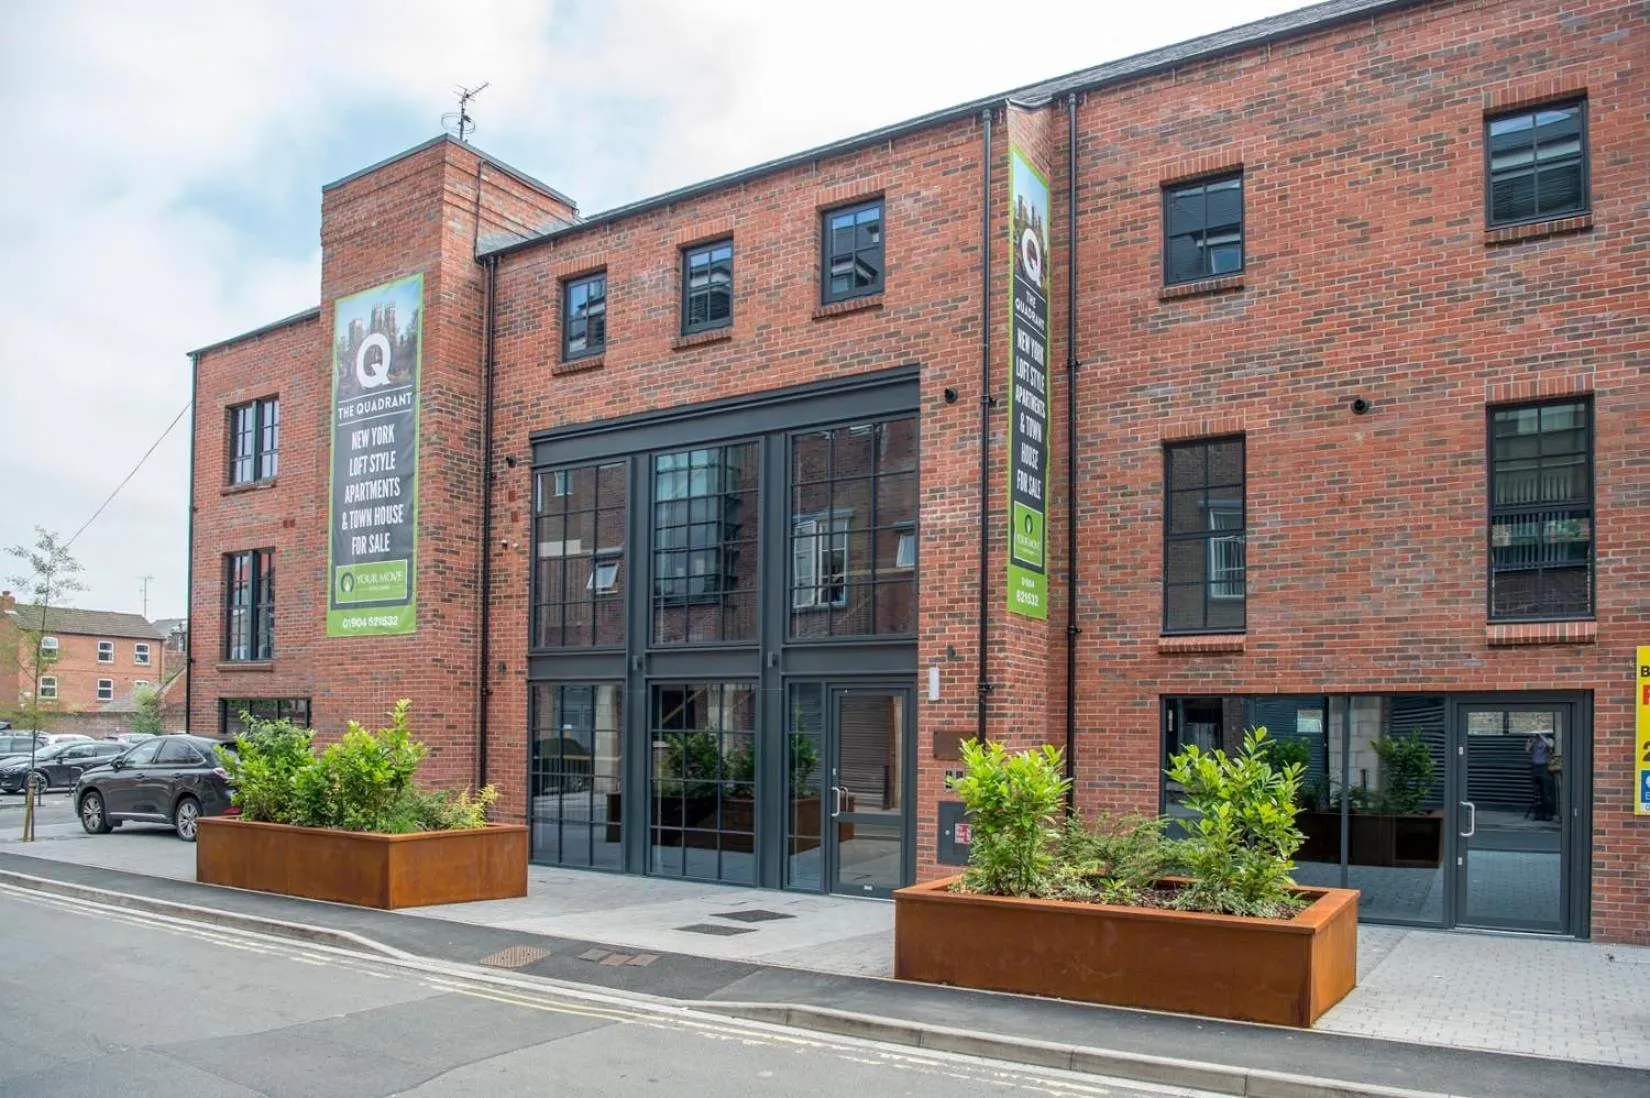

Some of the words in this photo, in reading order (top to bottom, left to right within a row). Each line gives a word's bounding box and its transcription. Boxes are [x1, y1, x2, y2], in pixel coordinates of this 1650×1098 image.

[1021, 228, 1041, 288] Q
[1026, 290, 1036, 309] THE
[1015, 298, 1045, 331] QUADRANT
[1017, 327, 1031, 355] NEW
[1031, 337, 1044, 367] YORK
[356, 332, 392, 390] Q
[1015, 356, 1030, 382] LOFT
[1030, 365, 1045, 394] STYLE
[338, 407, 354, 419] THE
[357, 392, 413, 414] QUADRANT
[1015, 384, 1046, 418] APARTMENTS
[351, 429, 371, 451] NEW
[371, 424, 395, 445] YORK
[1026, 415, 1042, 443] TOWN
[350, 456, 368, 476] LOFT
[369, 451, 396, 473] STYLE
[1021, 443, 1038, 470] HOUSE
[344, 477, 401, 503] APARTMENTS
[1016, 469, 1028, 492] FOR
[1028, 476, 1042, 500] SALE
[341, 513, 349, 531] &
[350, 508, 373, 530] TOWN
[374, 504, 404, 526] HOUSE
[351, 535, 367, 556] FOR
[368, 533, 391, 554] SALE
[379, 570, 404, 583] MOVE
